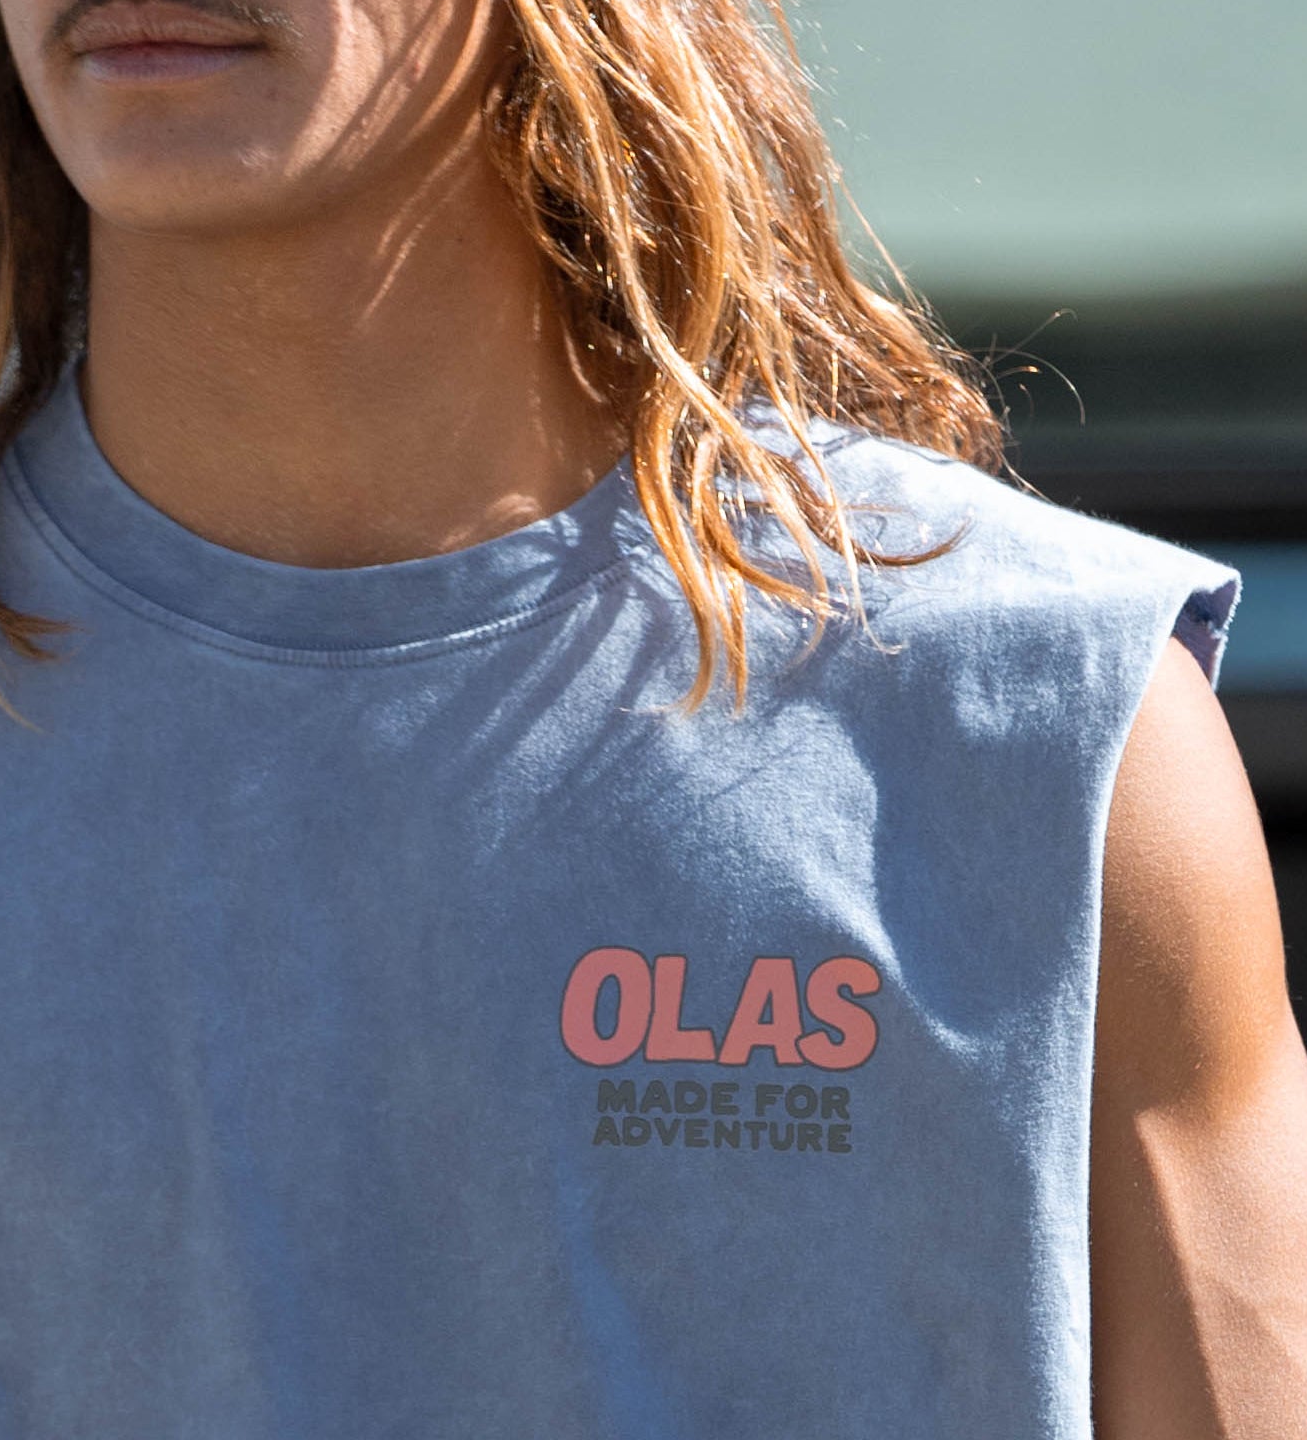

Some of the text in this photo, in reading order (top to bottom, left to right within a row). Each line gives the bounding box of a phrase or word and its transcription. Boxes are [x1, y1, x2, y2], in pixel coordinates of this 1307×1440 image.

[560, 946, 882, 1071] OLAS
[597, 1079, 851, 1118] MADE FOR
[593, 1116, 852, 1153] ADVENTURE
